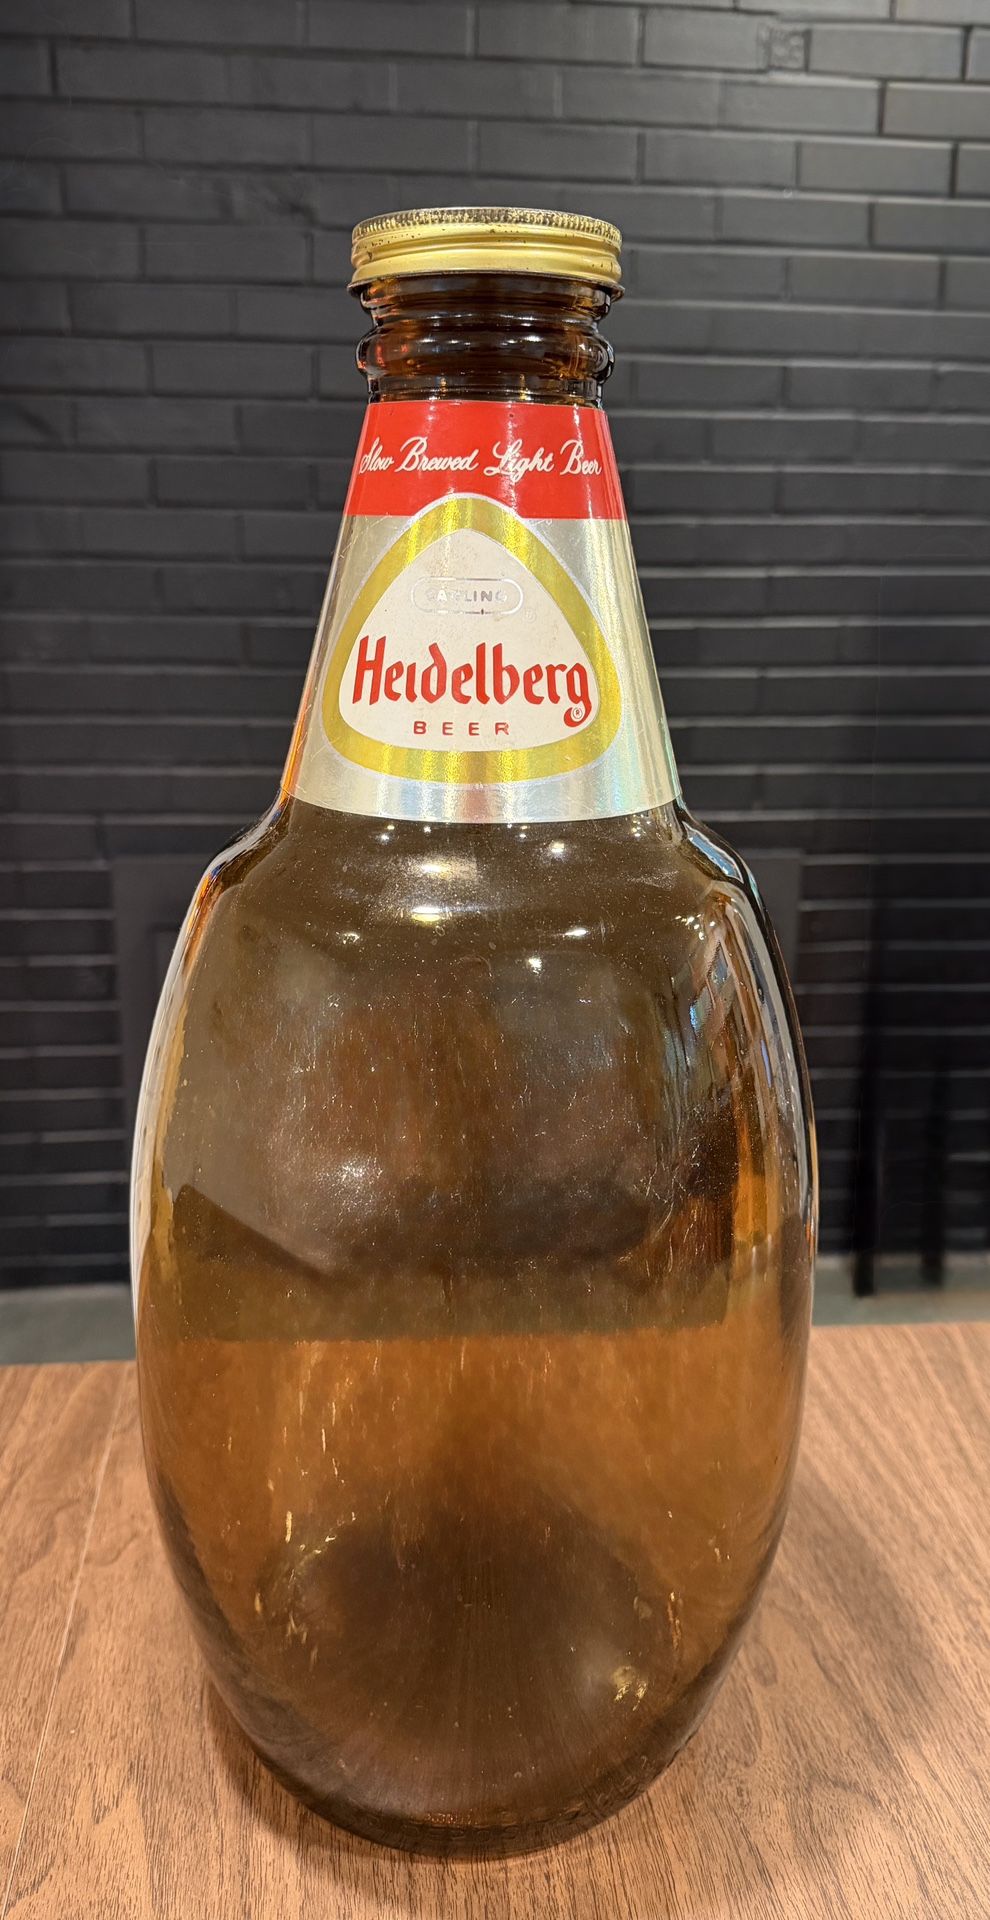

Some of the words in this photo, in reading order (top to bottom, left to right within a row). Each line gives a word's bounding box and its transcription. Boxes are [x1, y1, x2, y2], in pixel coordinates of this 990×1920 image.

[359, 436, 394, 475] Slow
[394, 436, 479, 472] Brewed
[484, 438, 554, 483] Light
[560, 439, 602, 476] Beer
[426, 589, 508, 602] ALING
[352, 635, 592, 728] Heidelberg
[413, 720, 510, 736] BEER
